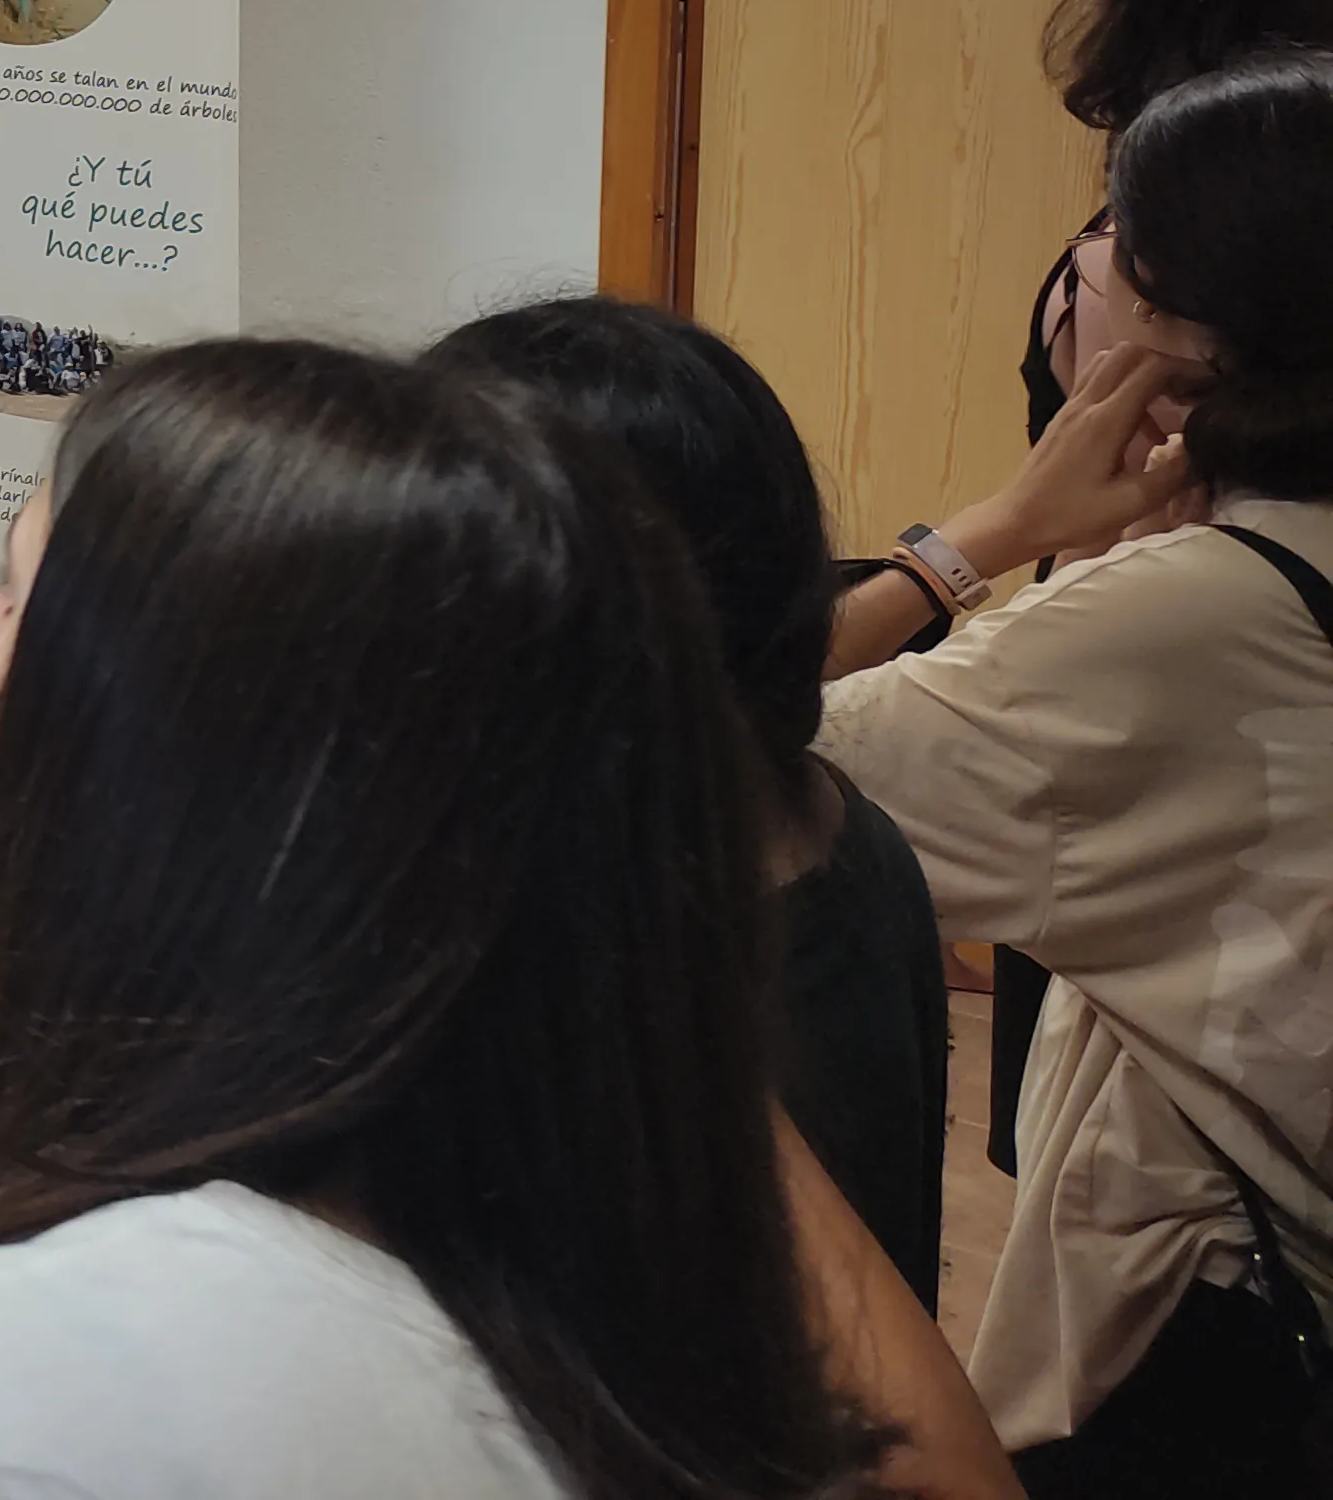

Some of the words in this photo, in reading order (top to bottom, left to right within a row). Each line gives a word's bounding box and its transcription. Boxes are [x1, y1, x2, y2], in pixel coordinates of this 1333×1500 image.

[3, 65, 43, 82] años
[50, 70, 67, 83] se
[74, 71, 119, 89] talan
[126, 77, 147, 91] en
[157, 76, 172, 93] el
[150, 98, 173, 114] de
[180, 100, 238, 123] árboles
[68, 155, 106, 187] ¿Y
[116, 159, 152, 189] tú
[22, 190, 76, 224] qué
[89, 201, 204, 233] puedes
[46, 229, 178, 271] hacer...?
